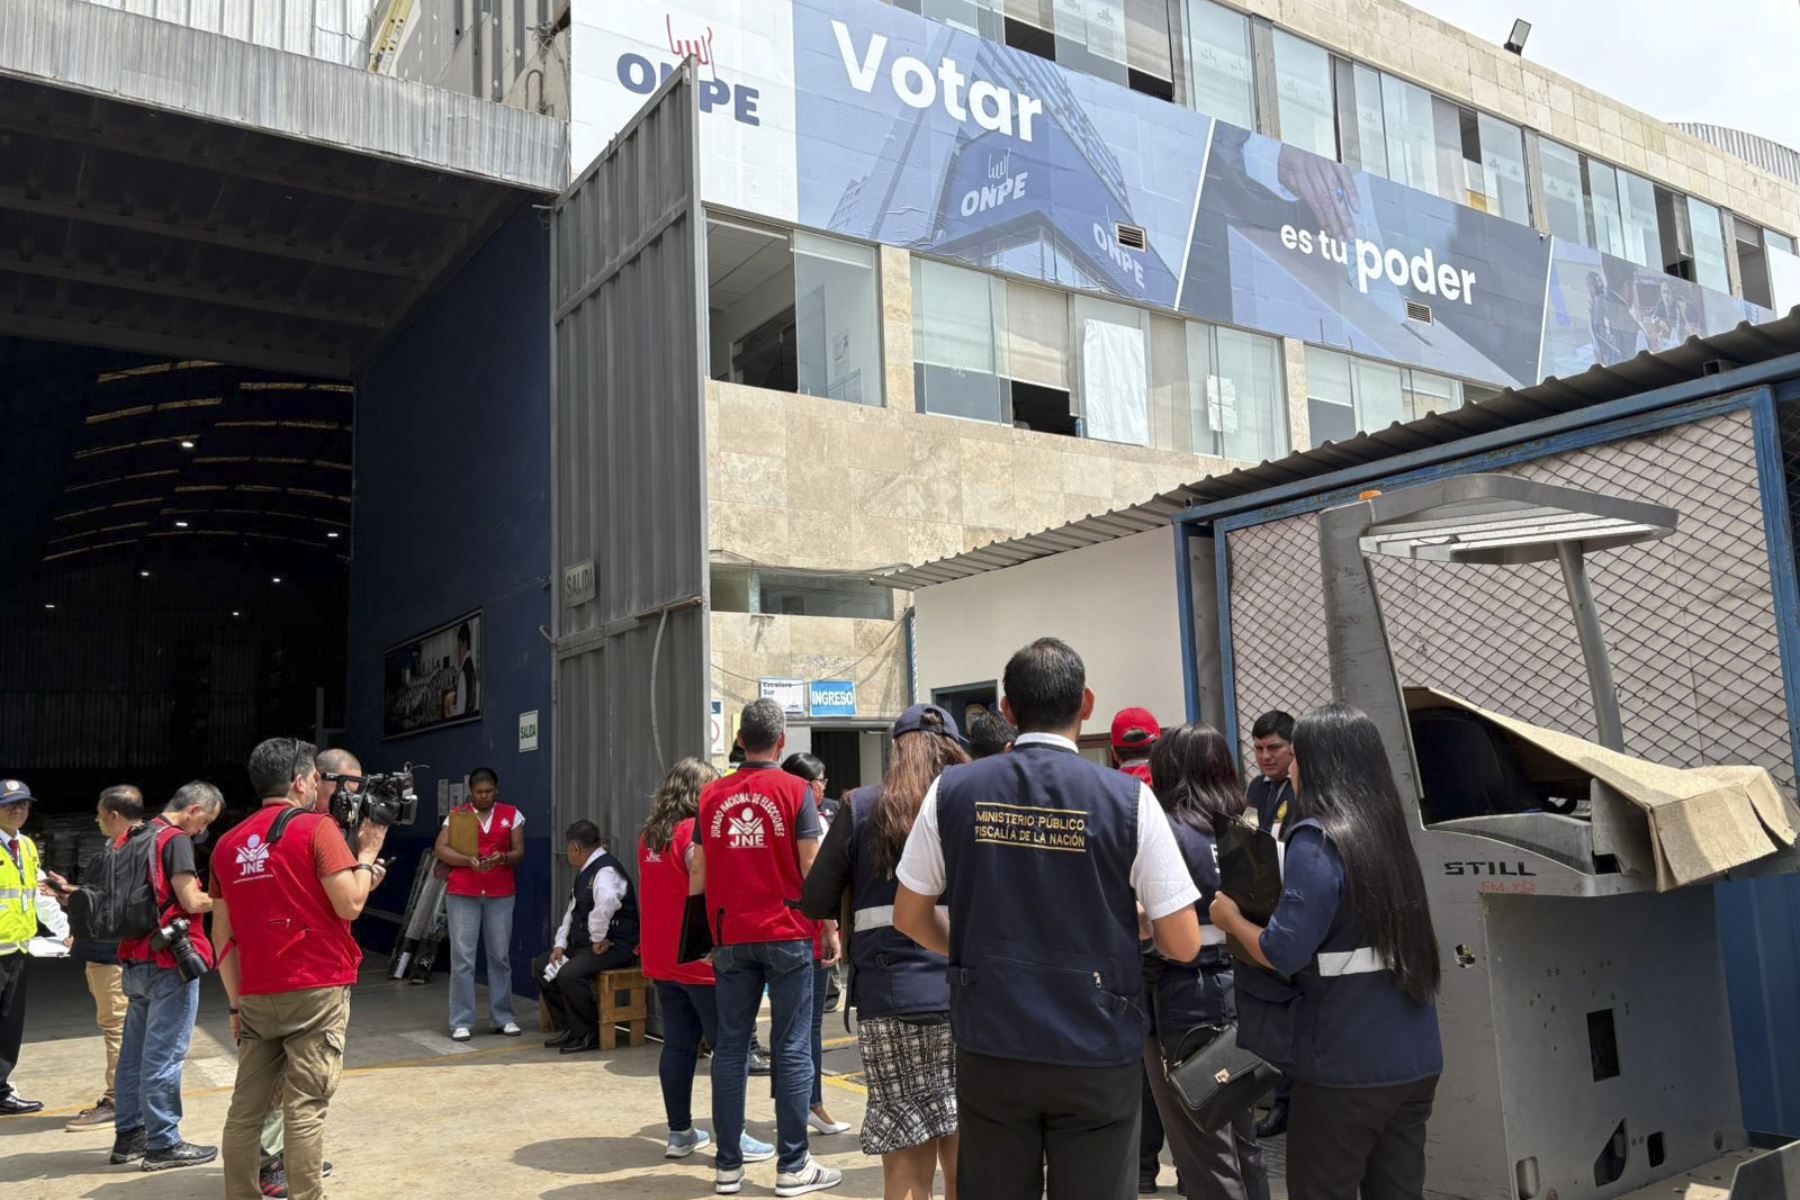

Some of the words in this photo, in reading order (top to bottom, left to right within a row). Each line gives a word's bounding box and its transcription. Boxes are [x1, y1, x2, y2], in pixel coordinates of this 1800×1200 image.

[616, 53, 760, 126] OPE
[831, 19, 1043, 143] Votar
[961, 171, 1028, 217] ONPE
[1093, 222, 1145, 290] ONPE
[1280, 224, 1313, 255] es
[1318, 229, 1349, 265] tu
[1355, 238, 1476, 306] poder
[811, 690, 854, 706] INGRESO
[520, 723, 536, 740] SALIDA
[710, 809, 724, 839] JURADO
[720, 792, 751, 813] NACIONAL
[751, 792, 762, 806] DE
[760, 796, 785, 837] ELECCIONES
[975, 811, 1035, 827] MINISTERIO
[1038, 813, 1085, 831] PÚBLICO
[729, 834, 765, 848] JNE
[975, 825, 1017, 840] FISCALÍA
[1019, 830, 1031, 841] DE
[1033, 832, 1046, 844] LA
[1049, 832, 1085, 847] NACIÓN
[240, 860, 265, 876] JNE
[1444, 862, 1537, 876] STILL
